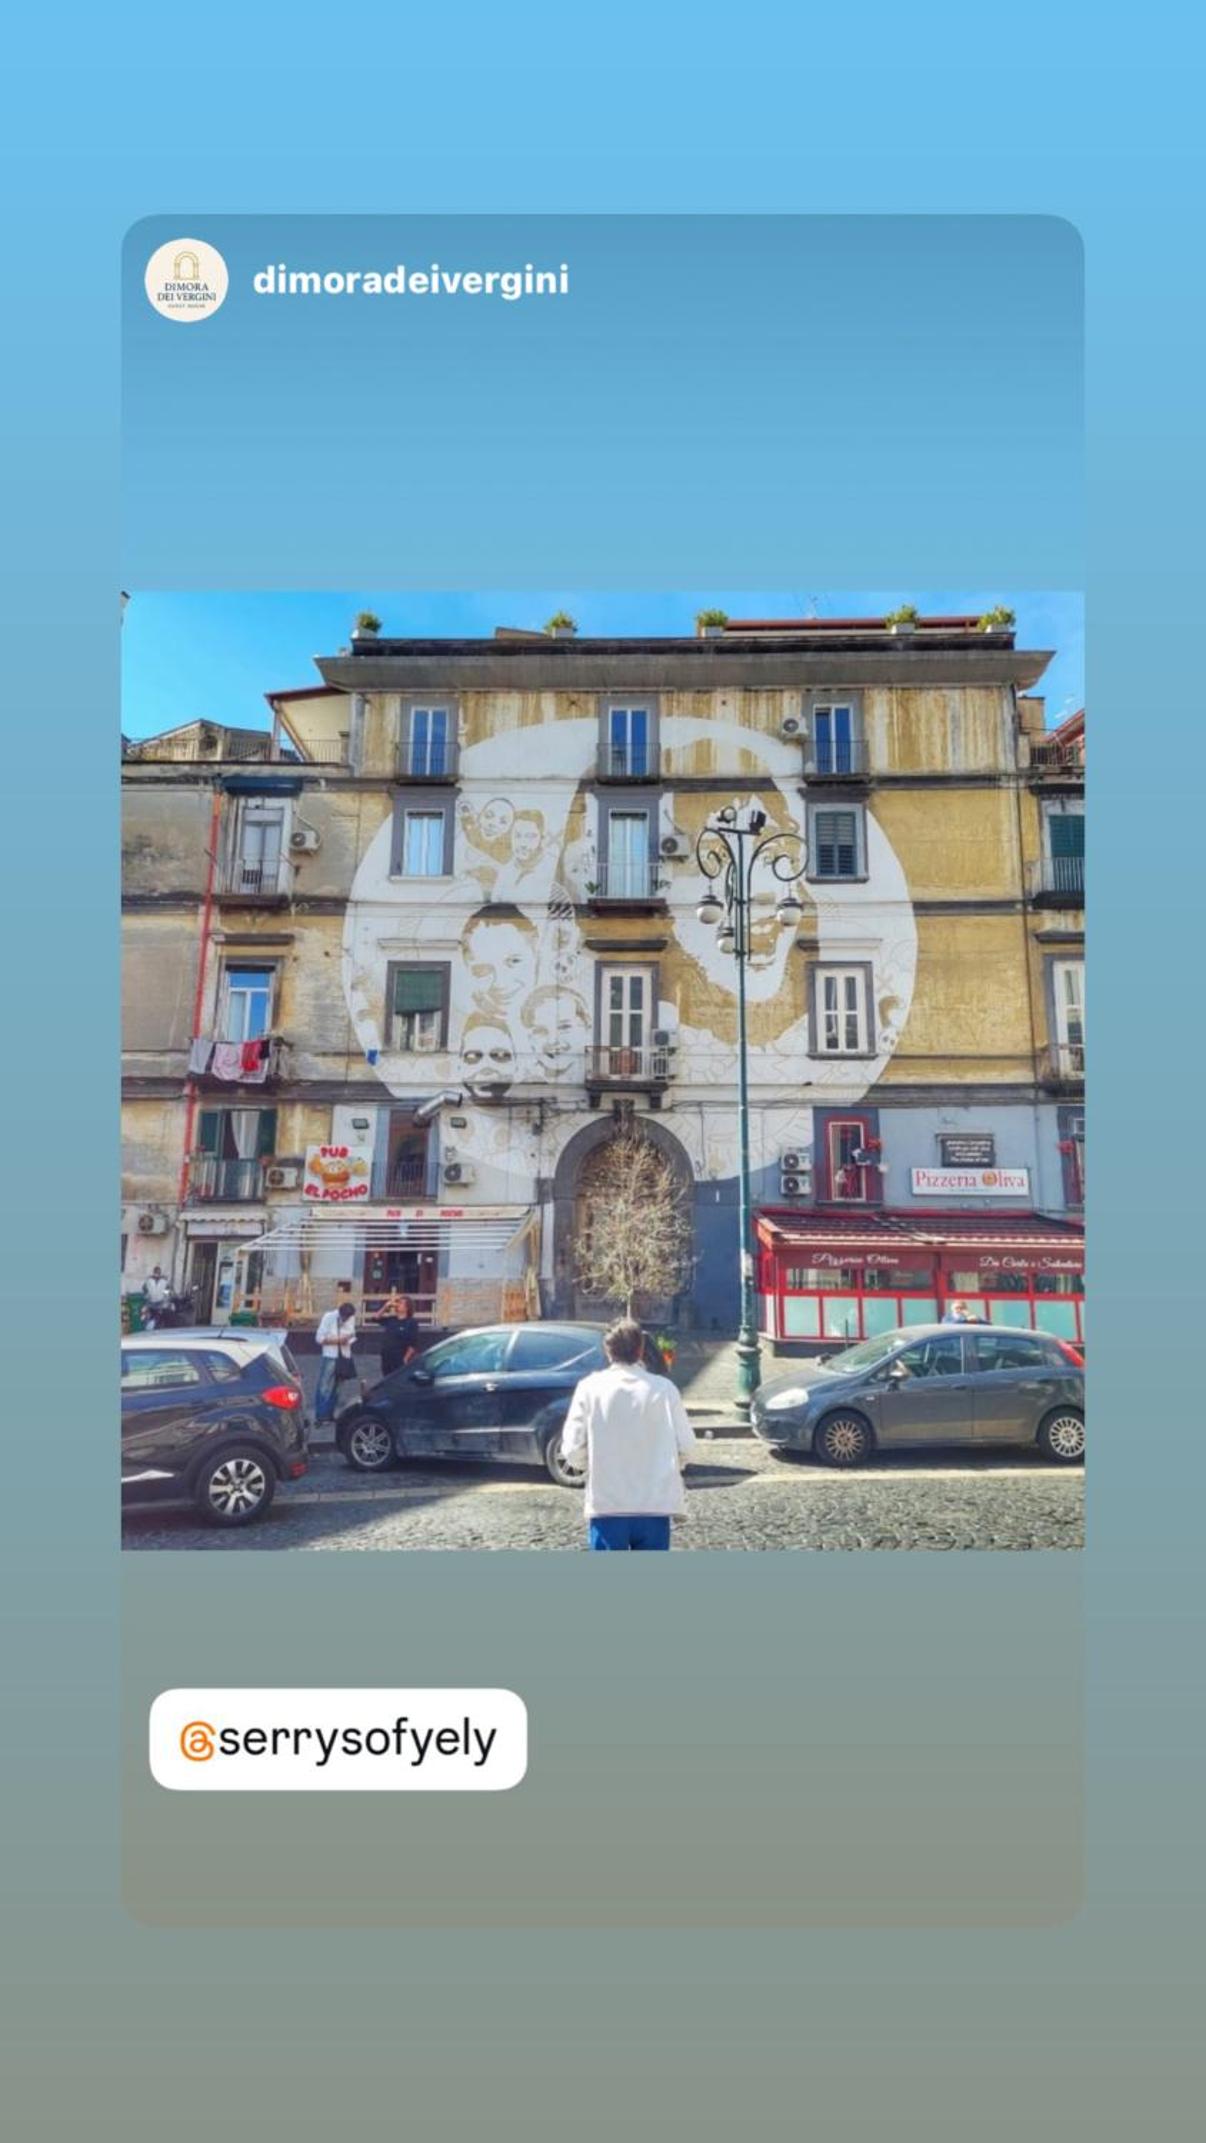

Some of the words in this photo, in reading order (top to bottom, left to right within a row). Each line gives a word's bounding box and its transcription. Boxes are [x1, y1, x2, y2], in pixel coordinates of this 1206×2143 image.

[320, 1146, 349, 1159] PUB
[915, 1170, 977, 1187] Pizzeria
[981, 1170, 1025, 1187] Oliva
